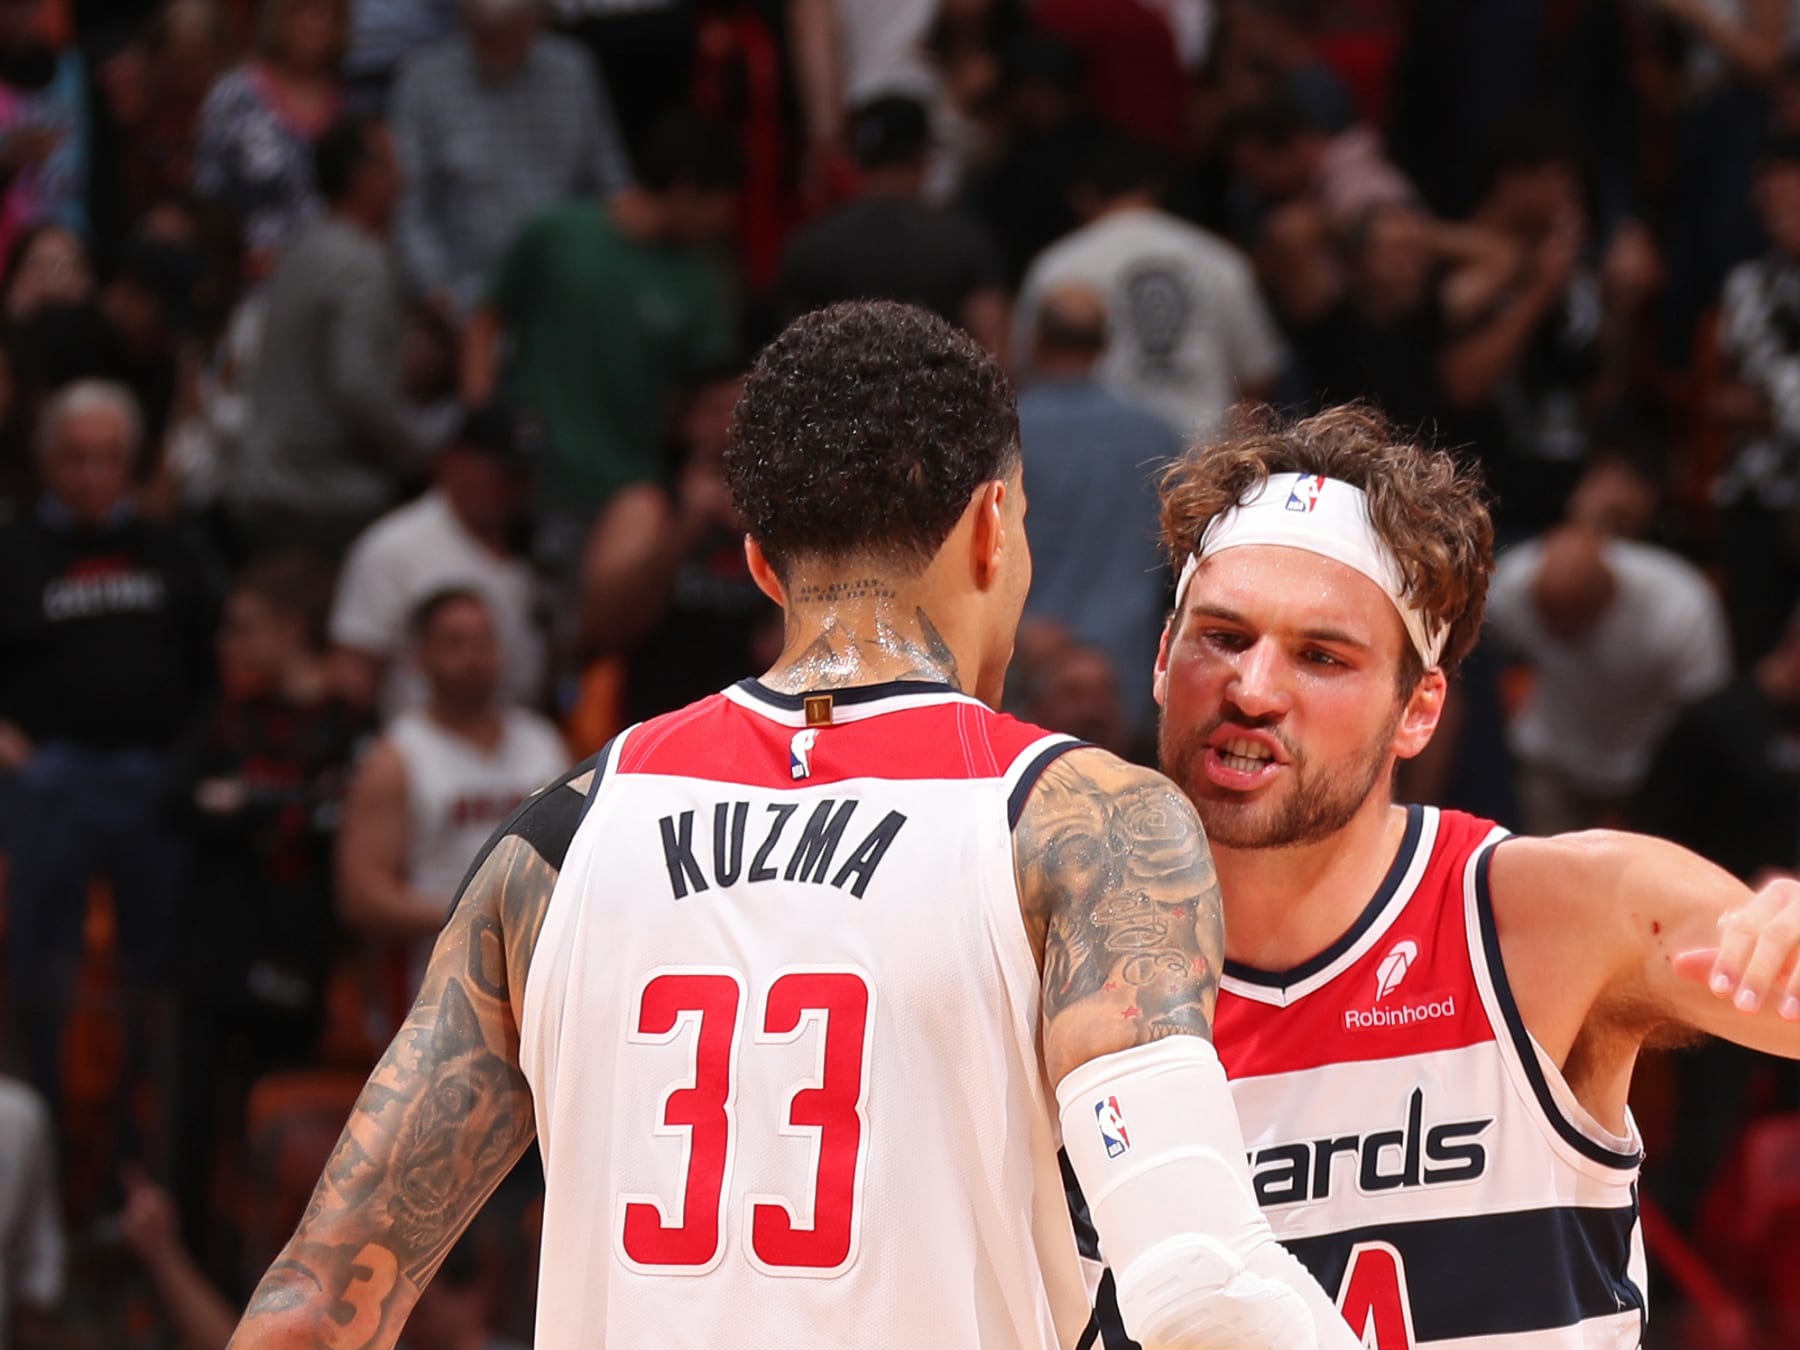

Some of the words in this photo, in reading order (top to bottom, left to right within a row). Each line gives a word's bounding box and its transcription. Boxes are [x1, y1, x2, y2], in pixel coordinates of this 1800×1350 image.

[658, 799, 908, 899] KUZMA
[1344, 995, 1455, 1029] Robinhood
[621, 970, 872, 1270] 33
[1246, 1086, 1495, 1207] ards
